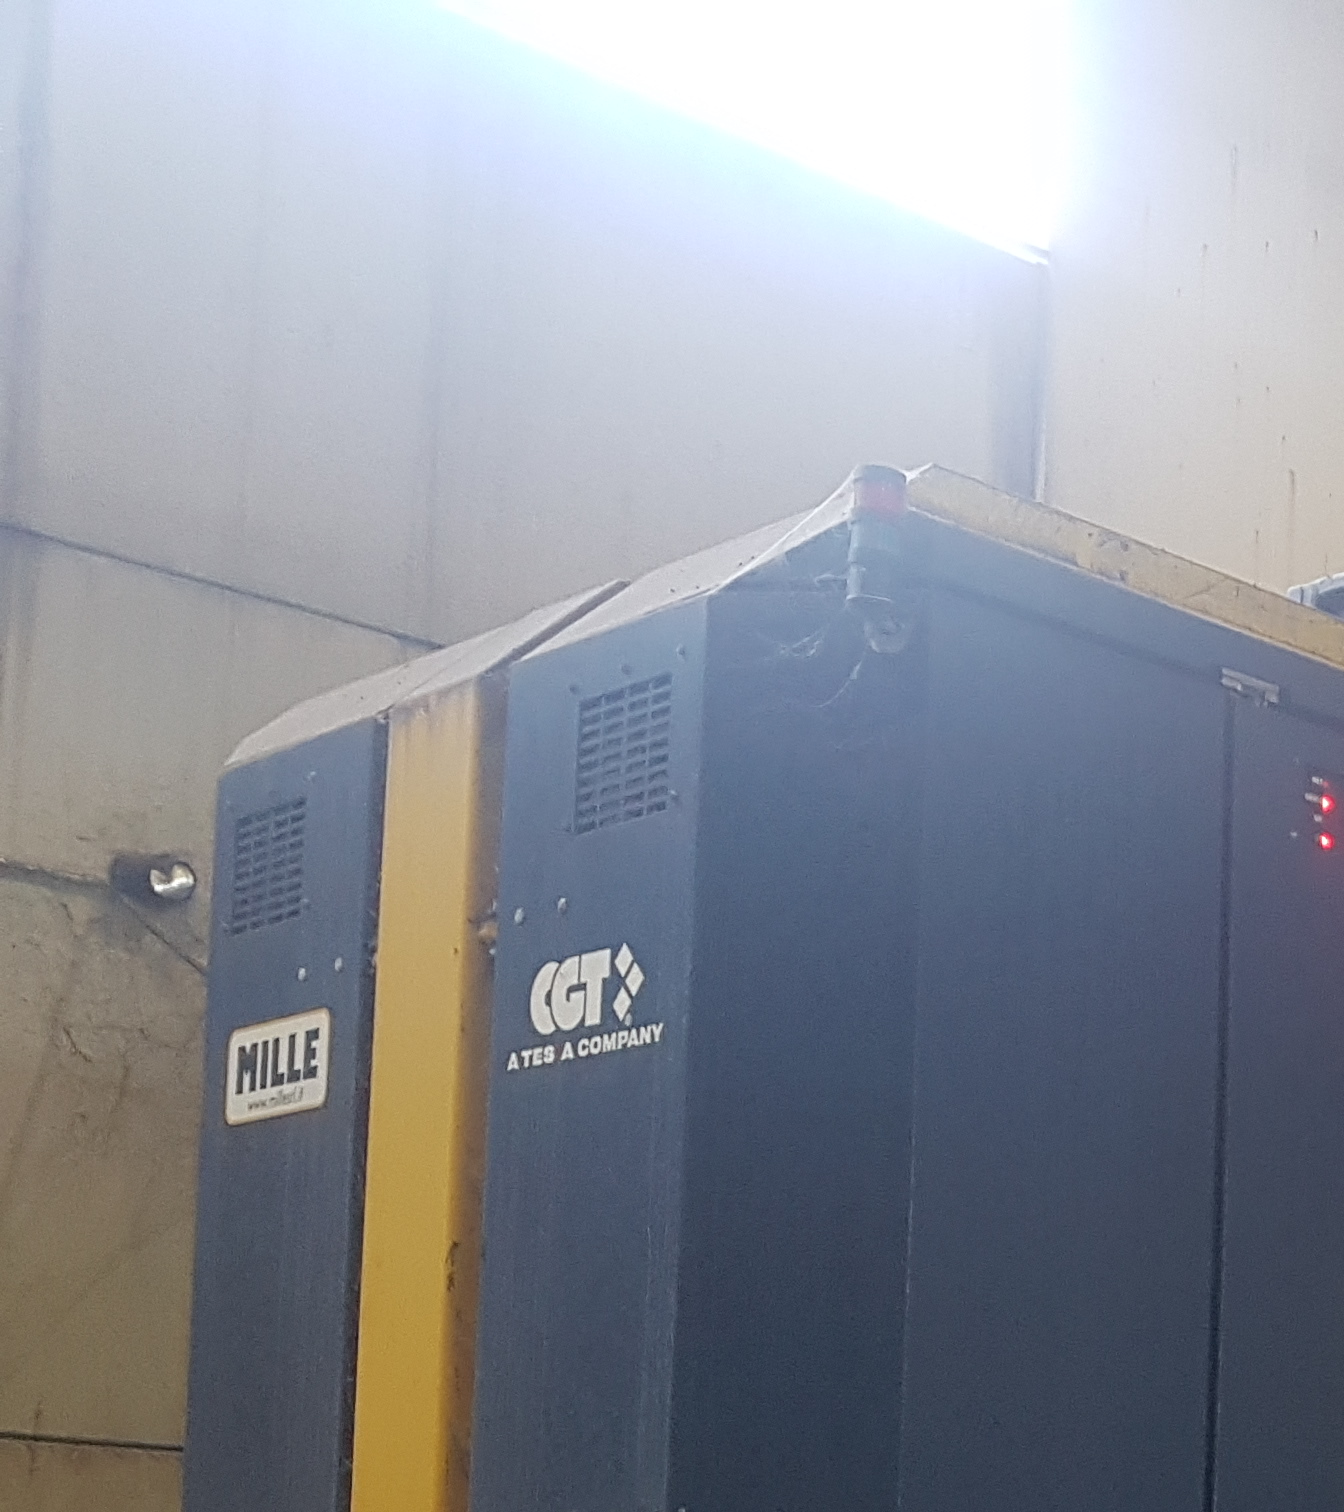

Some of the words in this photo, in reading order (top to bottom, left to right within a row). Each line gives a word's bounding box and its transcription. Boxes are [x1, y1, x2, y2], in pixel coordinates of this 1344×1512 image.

[530, 948, 611, 1035] CGT
[235, 1028, 320, 1095] MILLE
[560, 1042, 574, 1060] A
[577, 1023, 664, 1057] COMPANY
